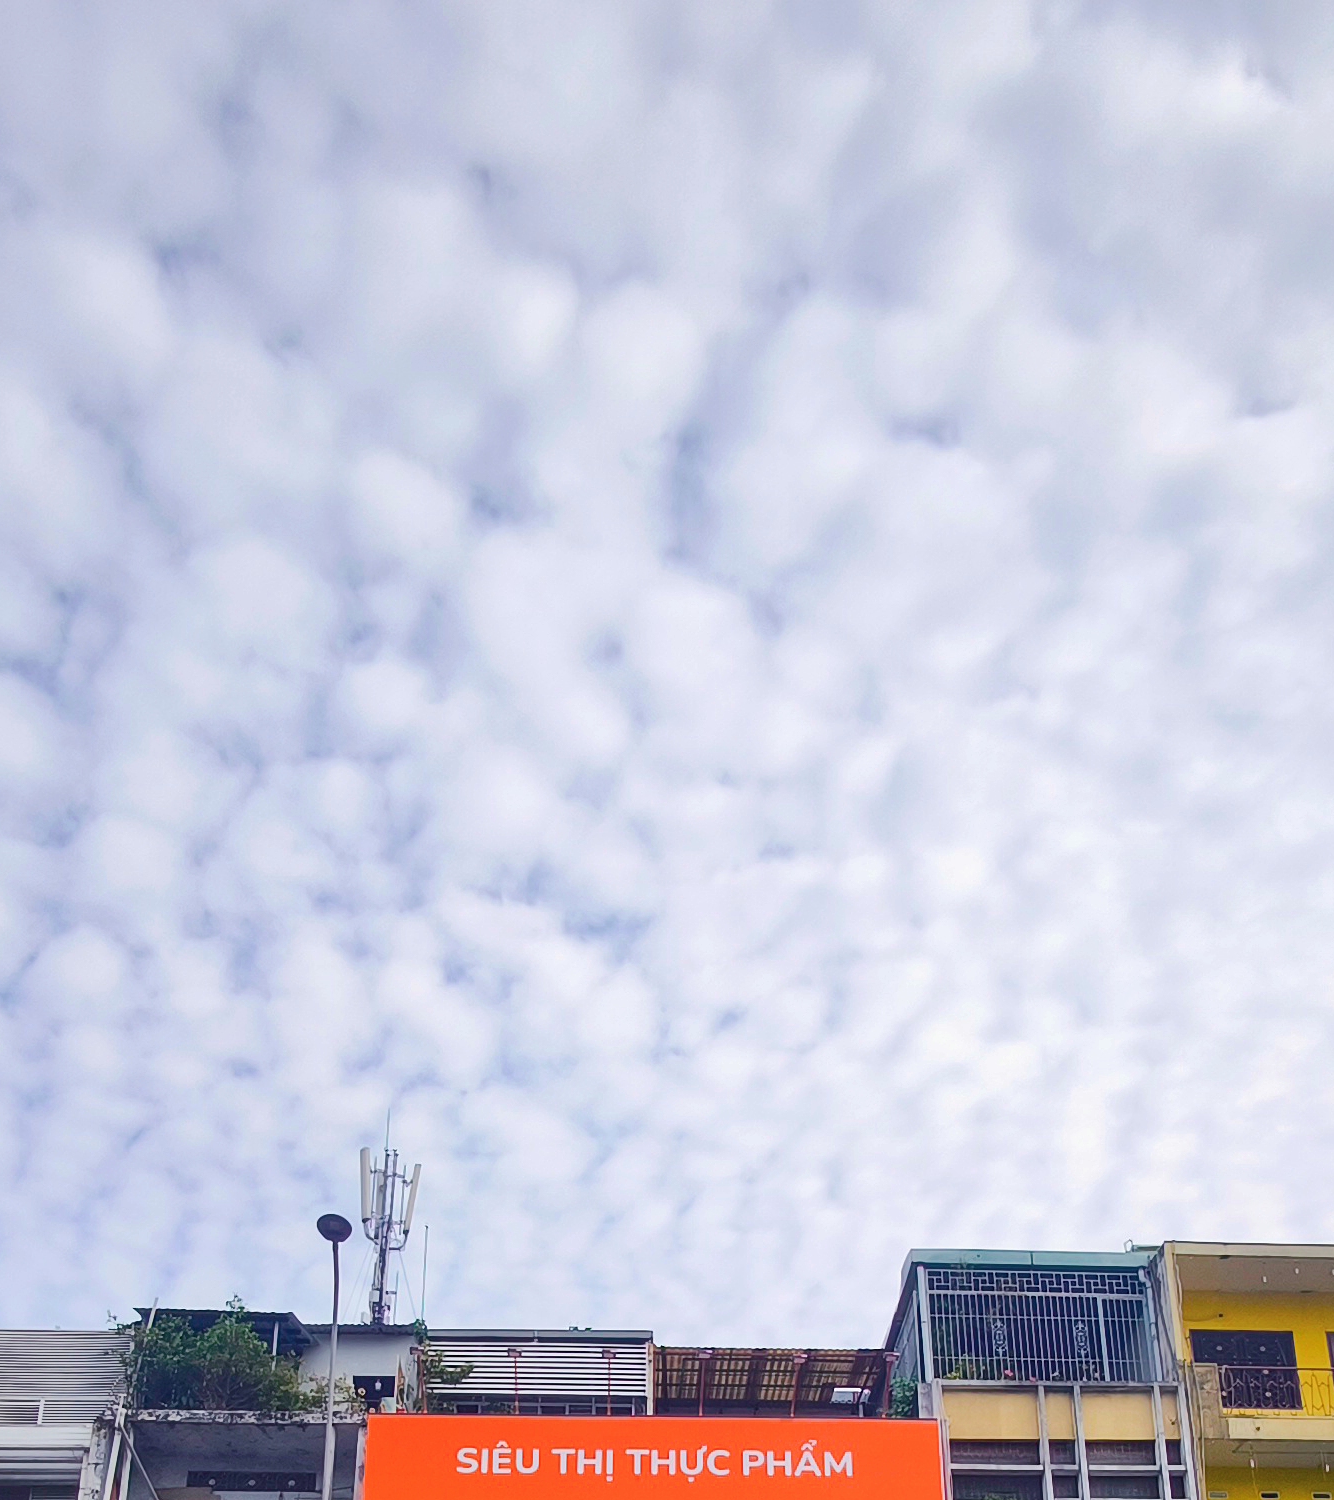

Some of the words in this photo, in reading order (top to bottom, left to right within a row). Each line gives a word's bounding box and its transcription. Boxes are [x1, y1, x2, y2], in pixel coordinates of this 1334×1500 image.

[456, 1441, 540, 1475] SIÊU
[551, 1448, 614, 1482] THỊ
[626, 1445, 730, 1482] THỰC
[742, 1440, 854, 1477] PHẨM
